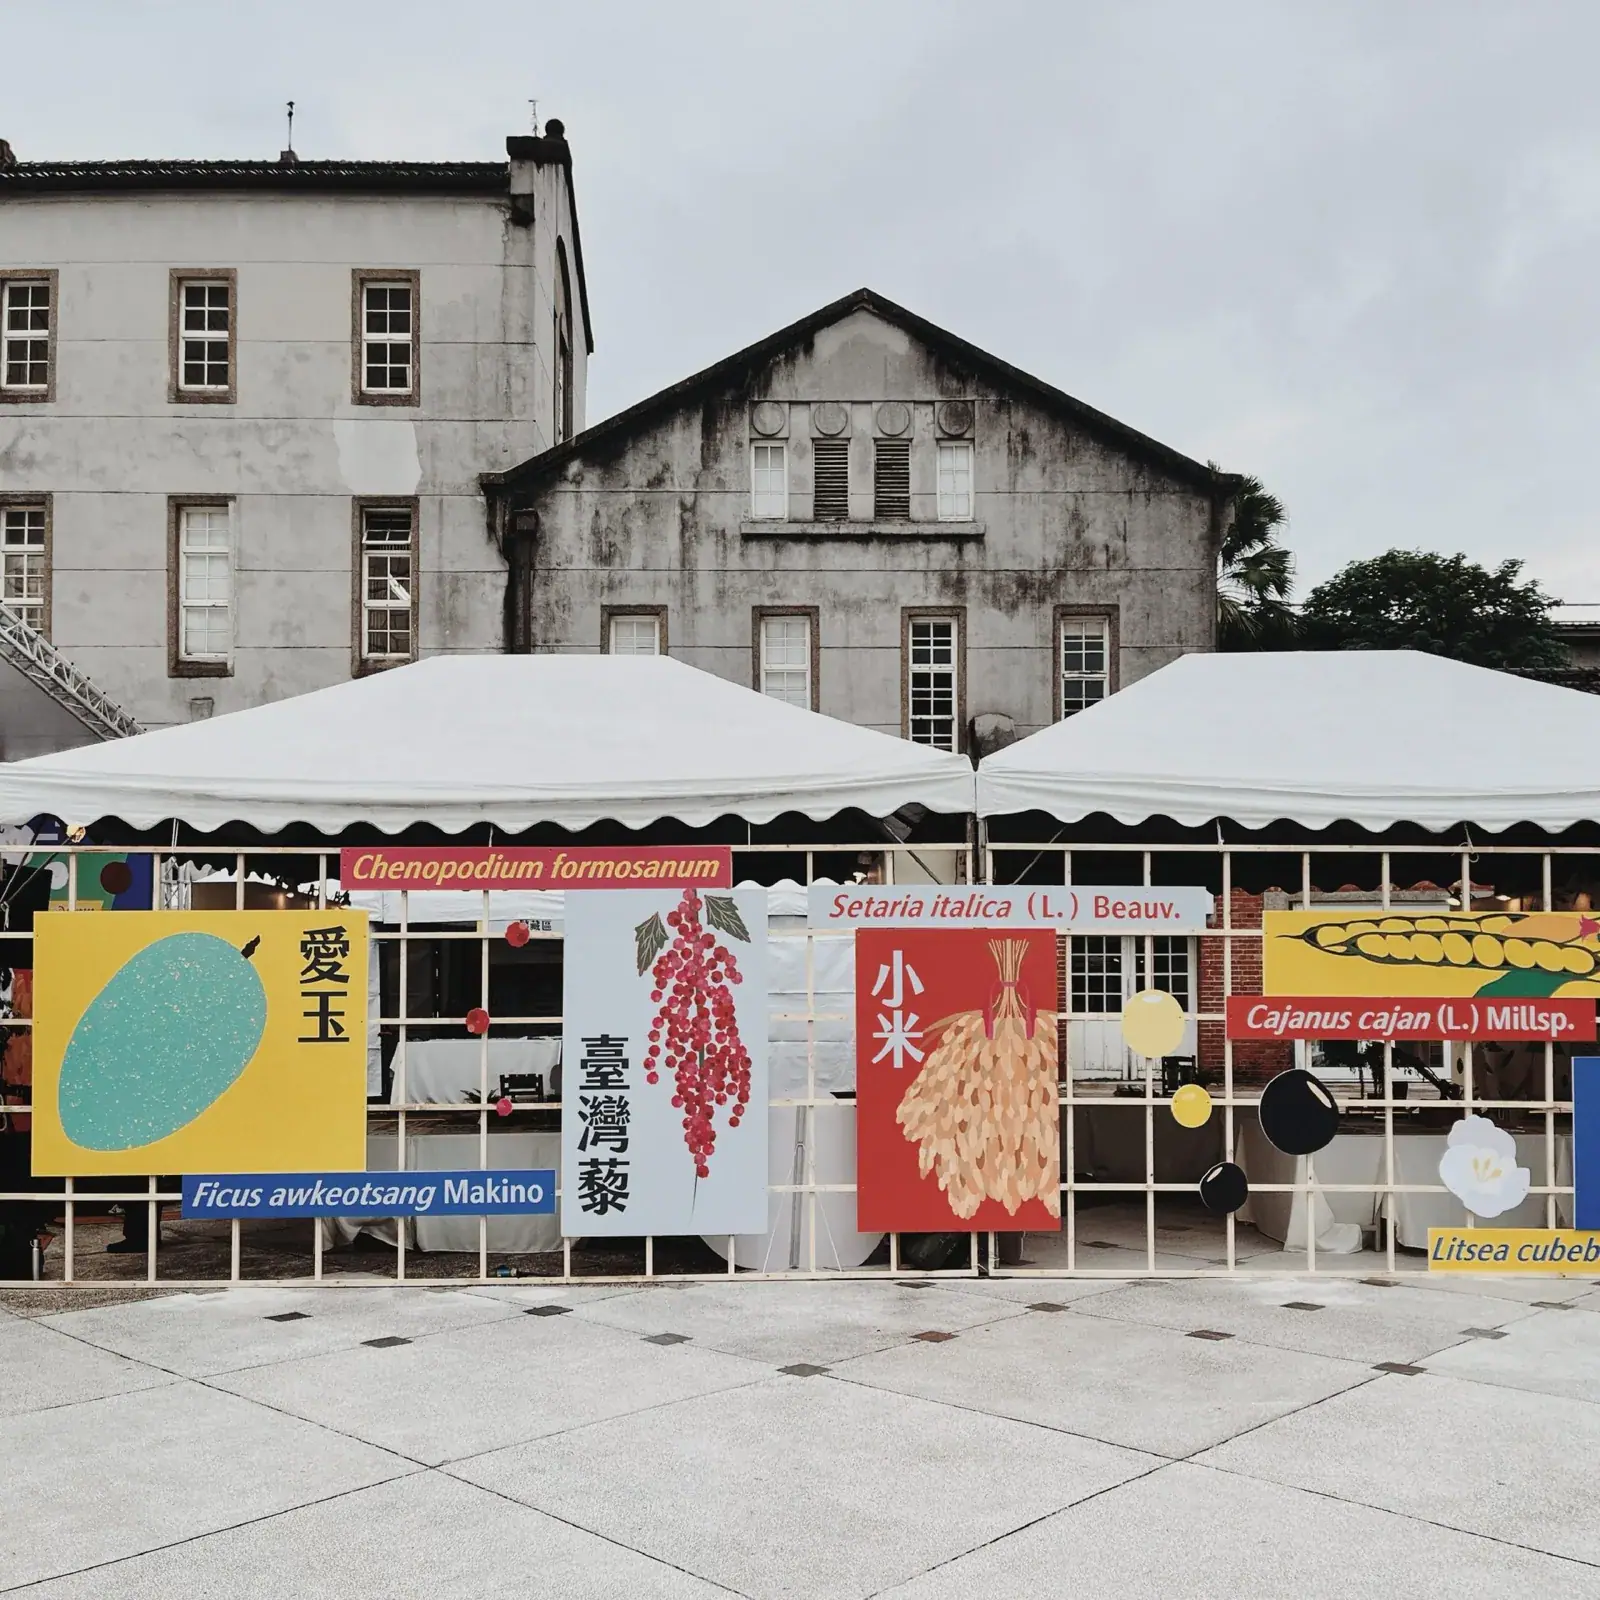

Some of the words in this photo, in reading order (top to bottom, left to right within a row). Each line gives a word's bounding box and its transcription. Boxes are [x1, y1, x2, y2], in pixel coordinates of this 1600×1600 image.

[352, 853, 544, 885] Chenopodium
[550, 852, 720, 879] formosanum
[829, 892, 924, 918] Setaria
[930, 892, 1012, 918] italica
[1094, 895, 1181, 919] Beauv.
[298, 925, 350, 1043] 愛玉
[871, 949, 925, 1069] 小米
[1246, 1005, 1351, 1036] Cajanus
[1358, 1005, 1431, 1036] cajan
[1437, 1003, 1479, 1034] (L.)
[1487, 1005, 1575, 1037] Millsp.
[577, 1033, 632, 1216] 臺灣藜
[191, 1181, 262, 1208] Ficus
[269, 1180, 435, 1212] awkeotsang
[443, 1178, 544, 1206] Makino
[1432, 1236, 1510, 1261] Litsea
[1516, 1237, 1600, 1262] cubeb
